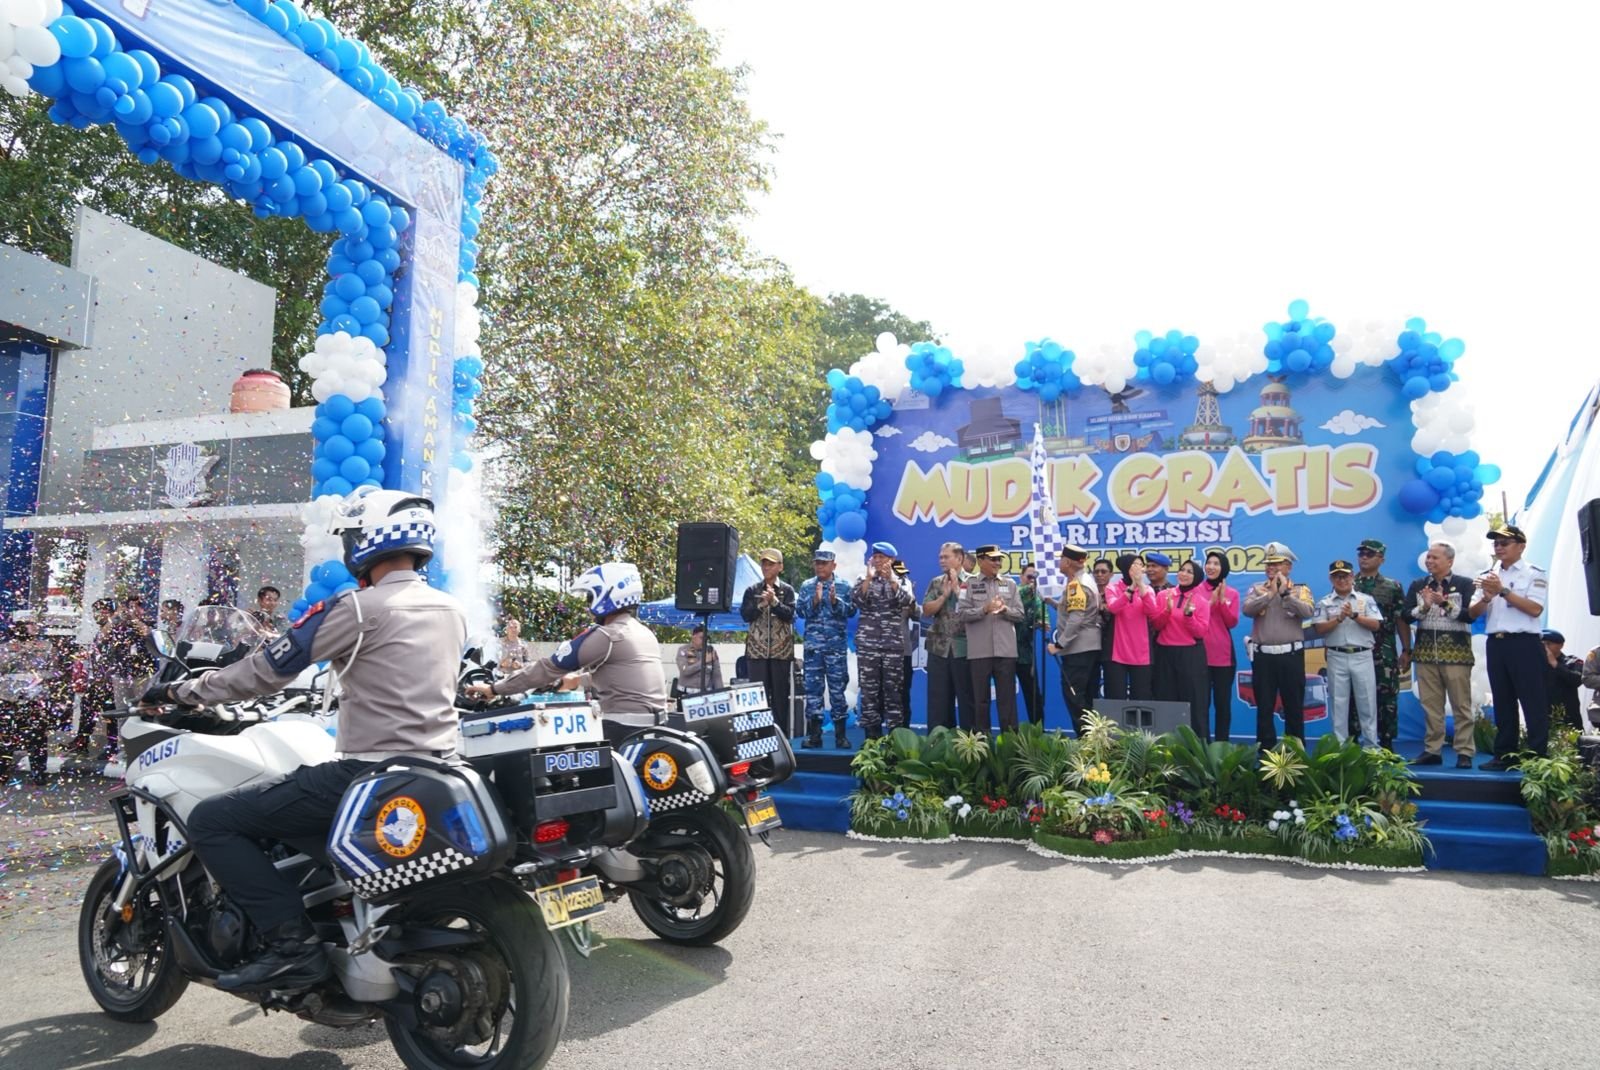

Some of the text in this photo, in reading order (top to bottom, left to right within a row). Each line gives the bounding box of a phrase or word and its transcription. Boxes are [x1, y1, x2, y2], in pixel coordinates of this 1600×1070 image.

[429, 307, 442, 391] MUDIK
[424, 398, 438, 464] AMAN
[1110, 446, 1379, 518] GRATIS
[1105, 521, 1231, 545] PRESISI
[689, 702, 731, 719] POLISI
[741, 691, 759, 706] PJR
[554, 714, 587, 735] PJR
[139, 739, 179, 770] POLISI
[545, 751, 600, 772] POLISI
